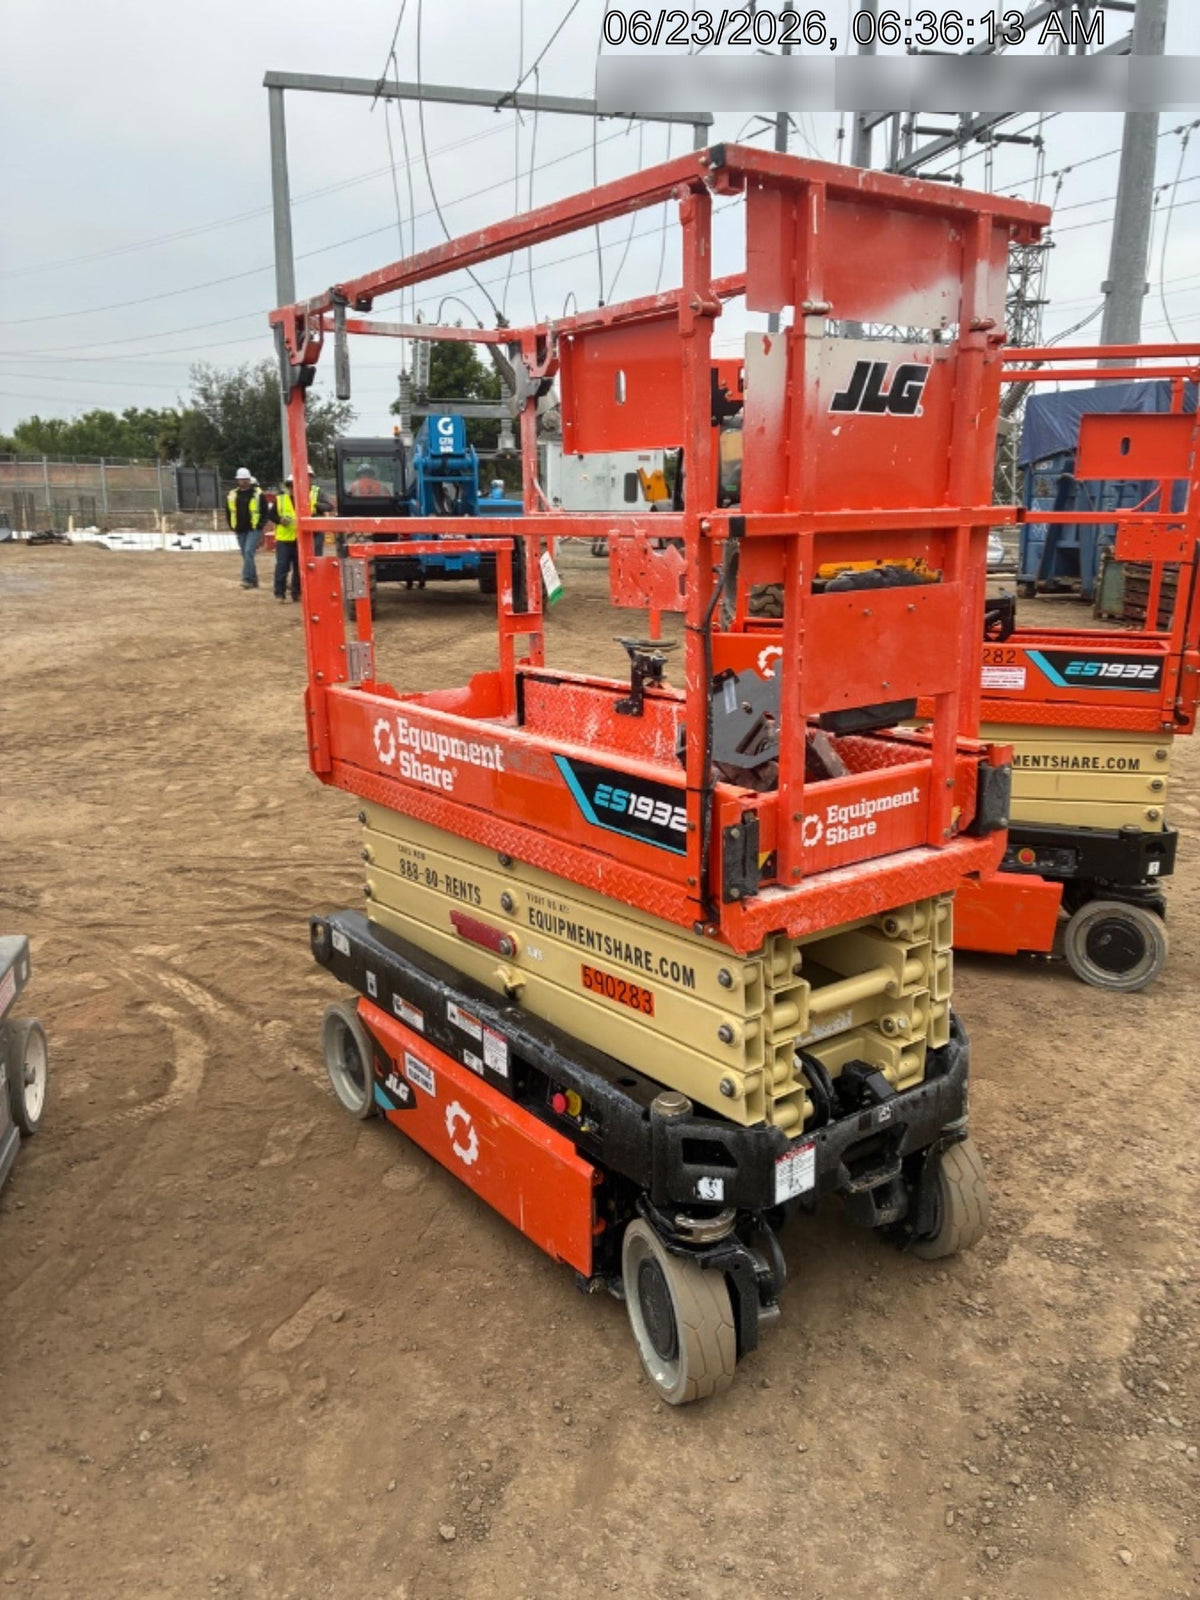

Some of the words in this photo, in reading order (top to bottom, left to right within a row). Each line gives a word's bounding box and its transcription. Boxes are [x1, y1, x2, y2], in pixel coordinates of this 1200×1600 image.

[828, 359, 932, 417] JLG
[1064, 660, 1160, 680] ES1932
[396, 716, 505, 772] Equipment
[593, 783, 688, 833] ES1932
[826, 786, 920, 825] Equipment
[825, 820, 877, 846] Share
[528, 906, 696, 989] EQUIPMENTSHARE.COM
[582, 965, 654, 1015] 590283
